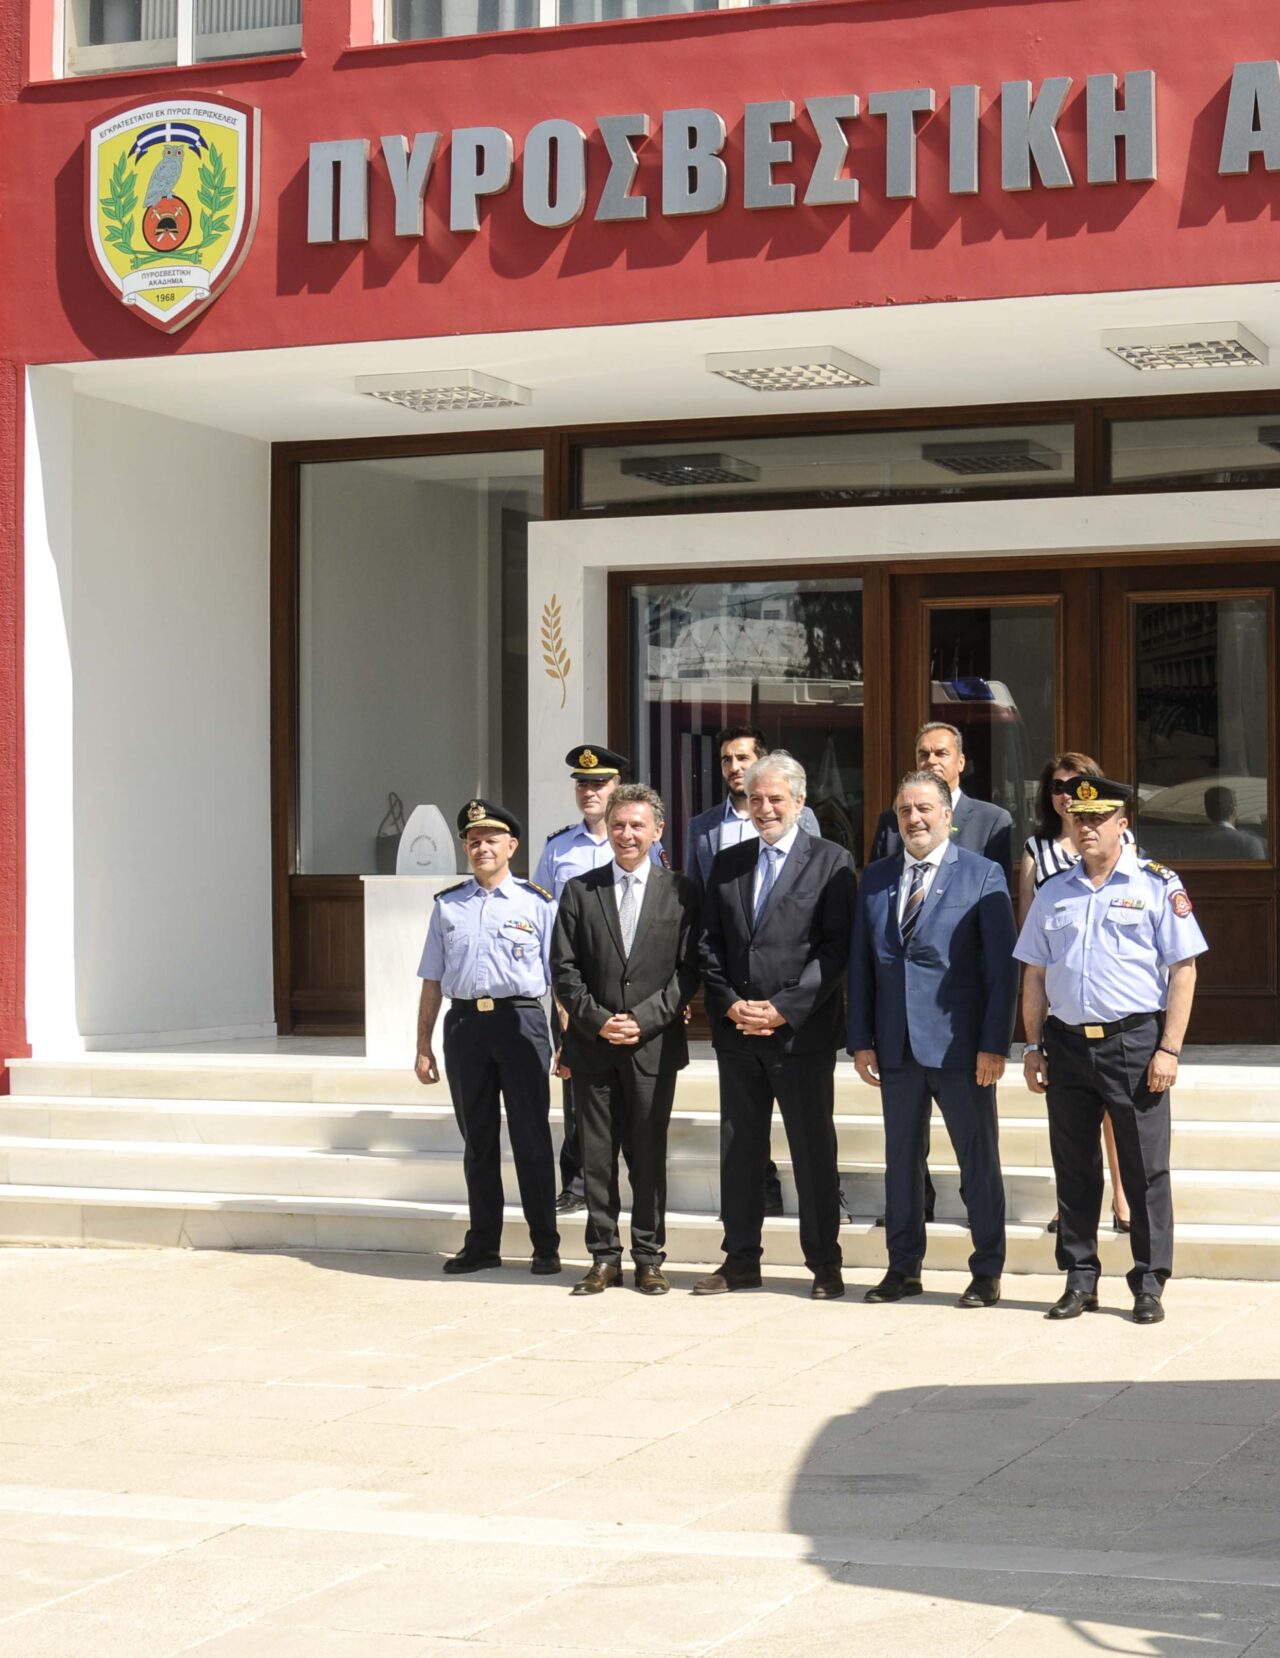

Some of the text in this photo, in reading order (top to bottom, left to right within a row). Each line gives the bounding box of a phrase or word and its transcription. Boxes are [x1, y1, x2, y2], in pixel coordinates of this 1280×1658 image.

[155, 109, 166, 118] ΕΚ
[166, 107, 191, 116] ΠΥΡΟΣ
[307, 70, 1157, 245] ΠΥΡΟΣΒΕΣΤΙΚΗ
[141, 269, 192, 280] ΠΥΡΟΣΒΕΣΤΙΚΗ
[148, 278, 184, 287] ΑΚΑΔΗΜΙΑ
[156, 293, 175, 303] 1968
